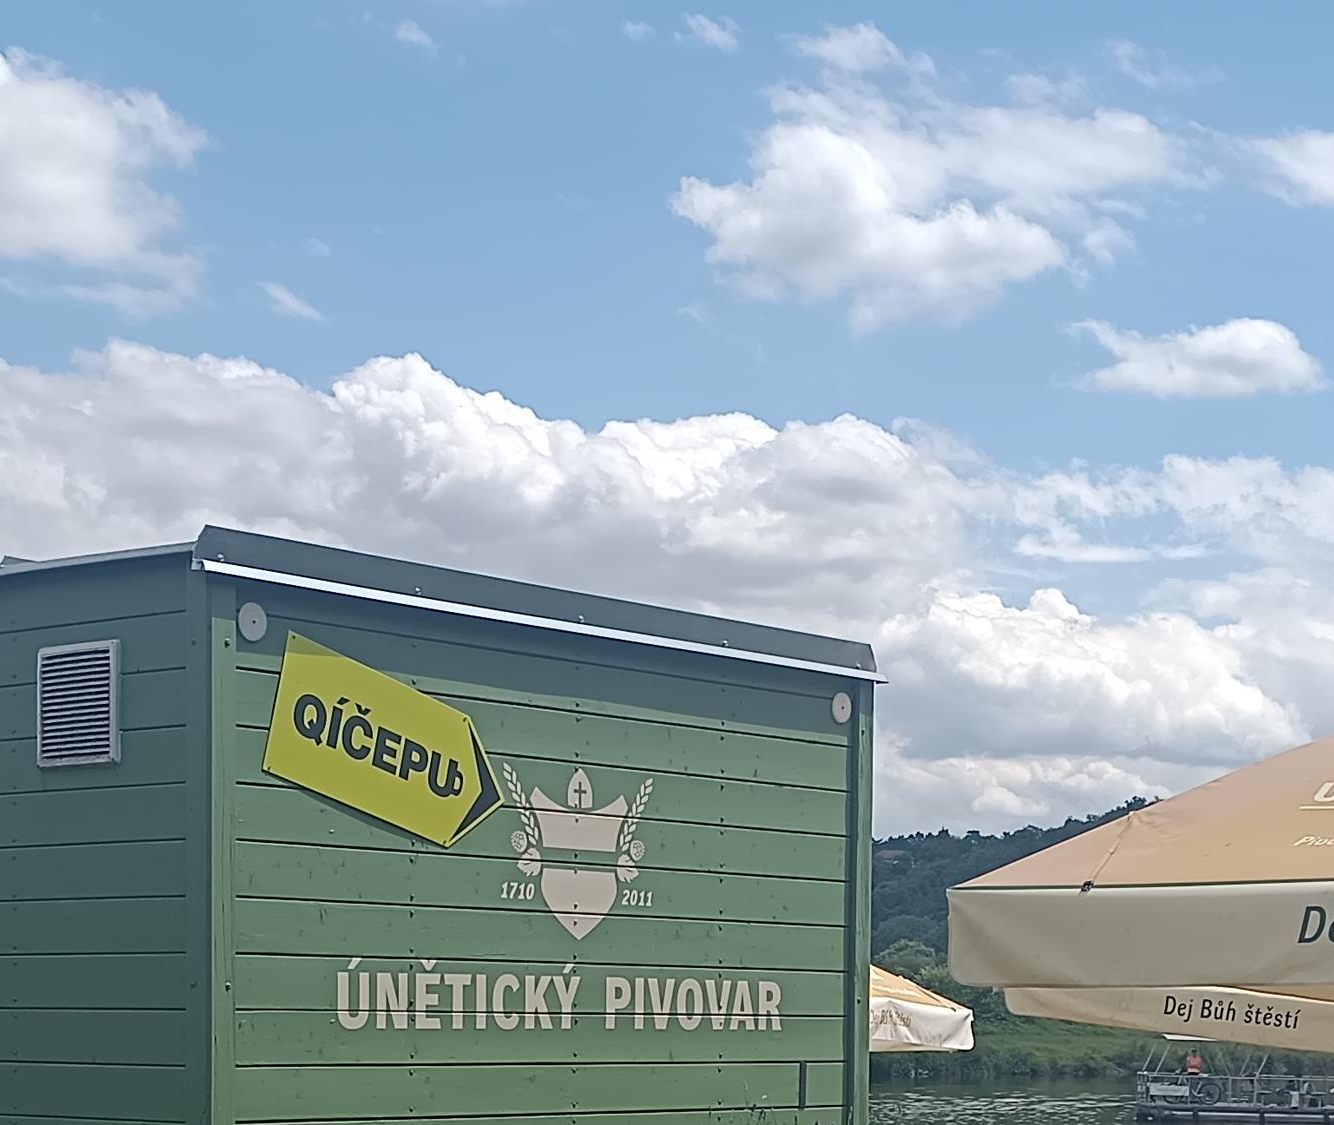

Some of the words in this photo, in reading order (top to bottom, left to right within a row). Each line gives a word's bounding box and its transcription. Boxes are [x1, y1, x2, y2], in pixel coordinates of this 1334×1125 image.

[500, 881, 536, 901] 1710
[620, 889, 654, 908] 2011
[336, 957, 582, 1031] ÚNĚTICKÝ
[604, 976, 784, 1032] PIVOVAR
[1163, 995, 1194, 1022] Dej
[1200, 998, 1237, 1022] Bůh
[1243, 1002, 1302, 1030] štěstí
